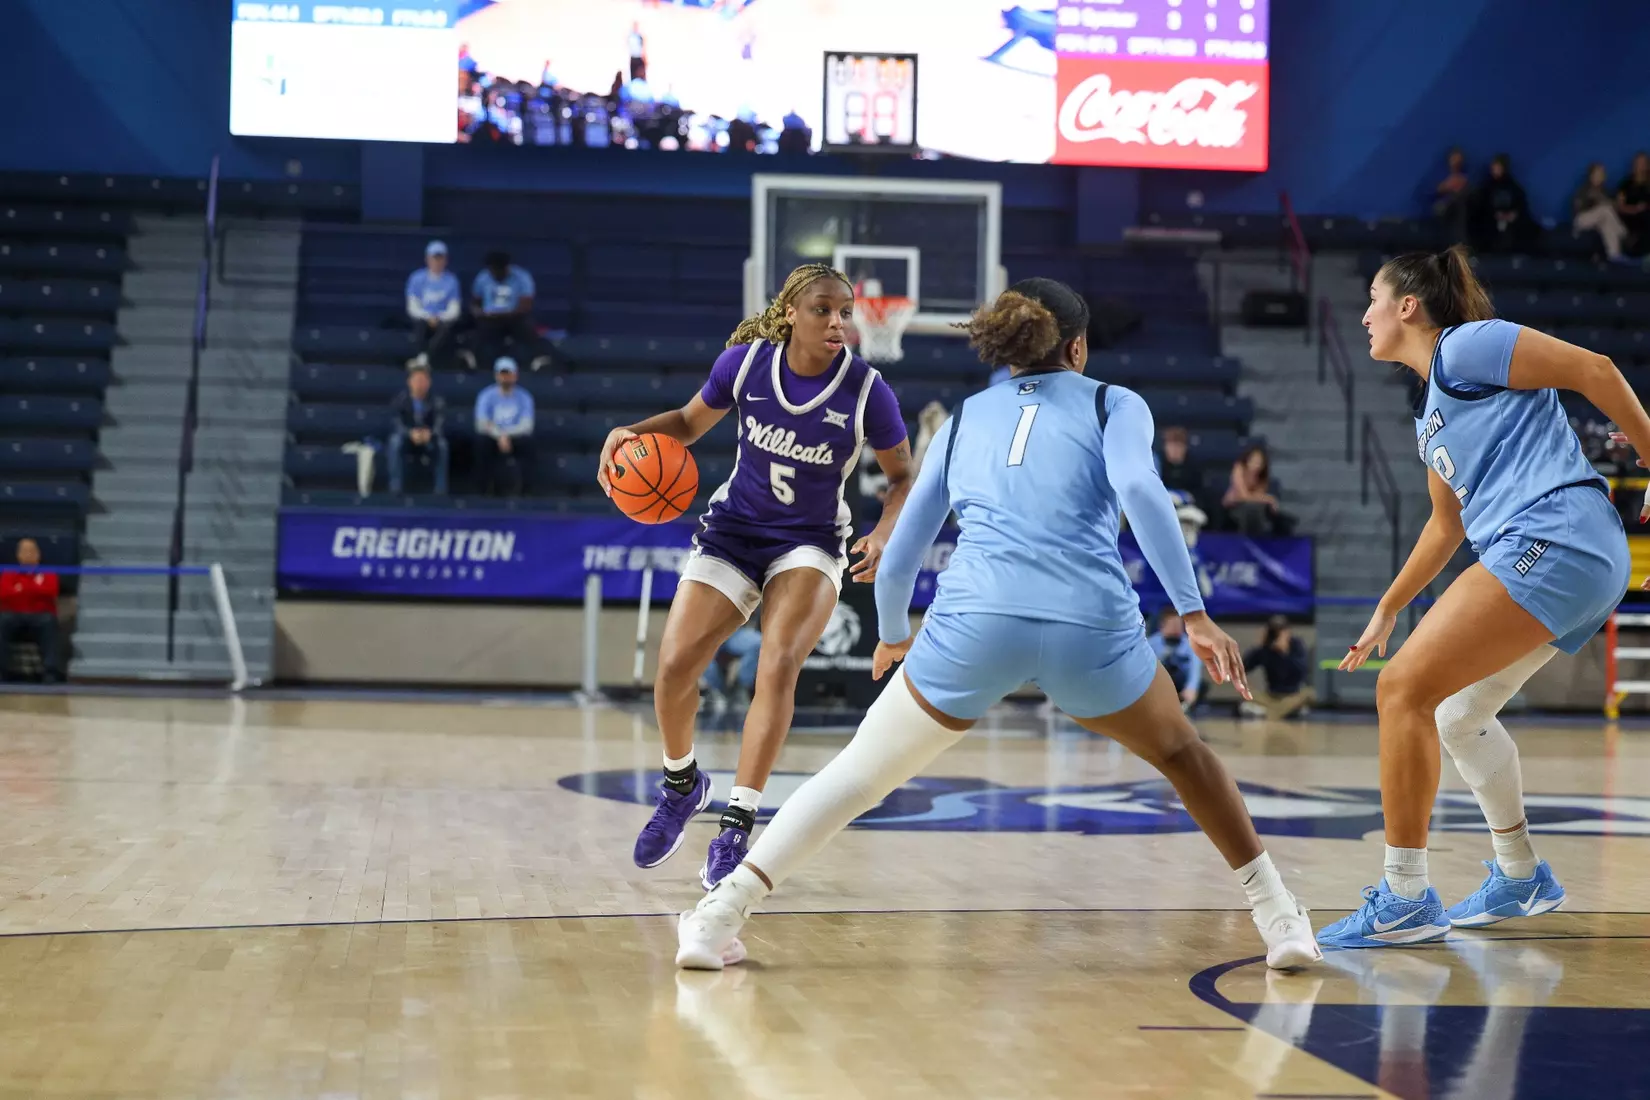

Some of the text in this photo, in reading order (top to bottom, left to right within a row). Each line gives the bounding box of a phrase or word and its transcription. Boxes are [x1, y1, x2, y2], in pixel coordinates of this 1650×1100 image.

[746, 415, 834, 465] Wildcats
[1006, 403, 1041, 467] 1
[769, 461, 796, 506] 5
[332, 526, 516, 562] CREIGHTON
[1513, 539, 1551, 577] BLUE
